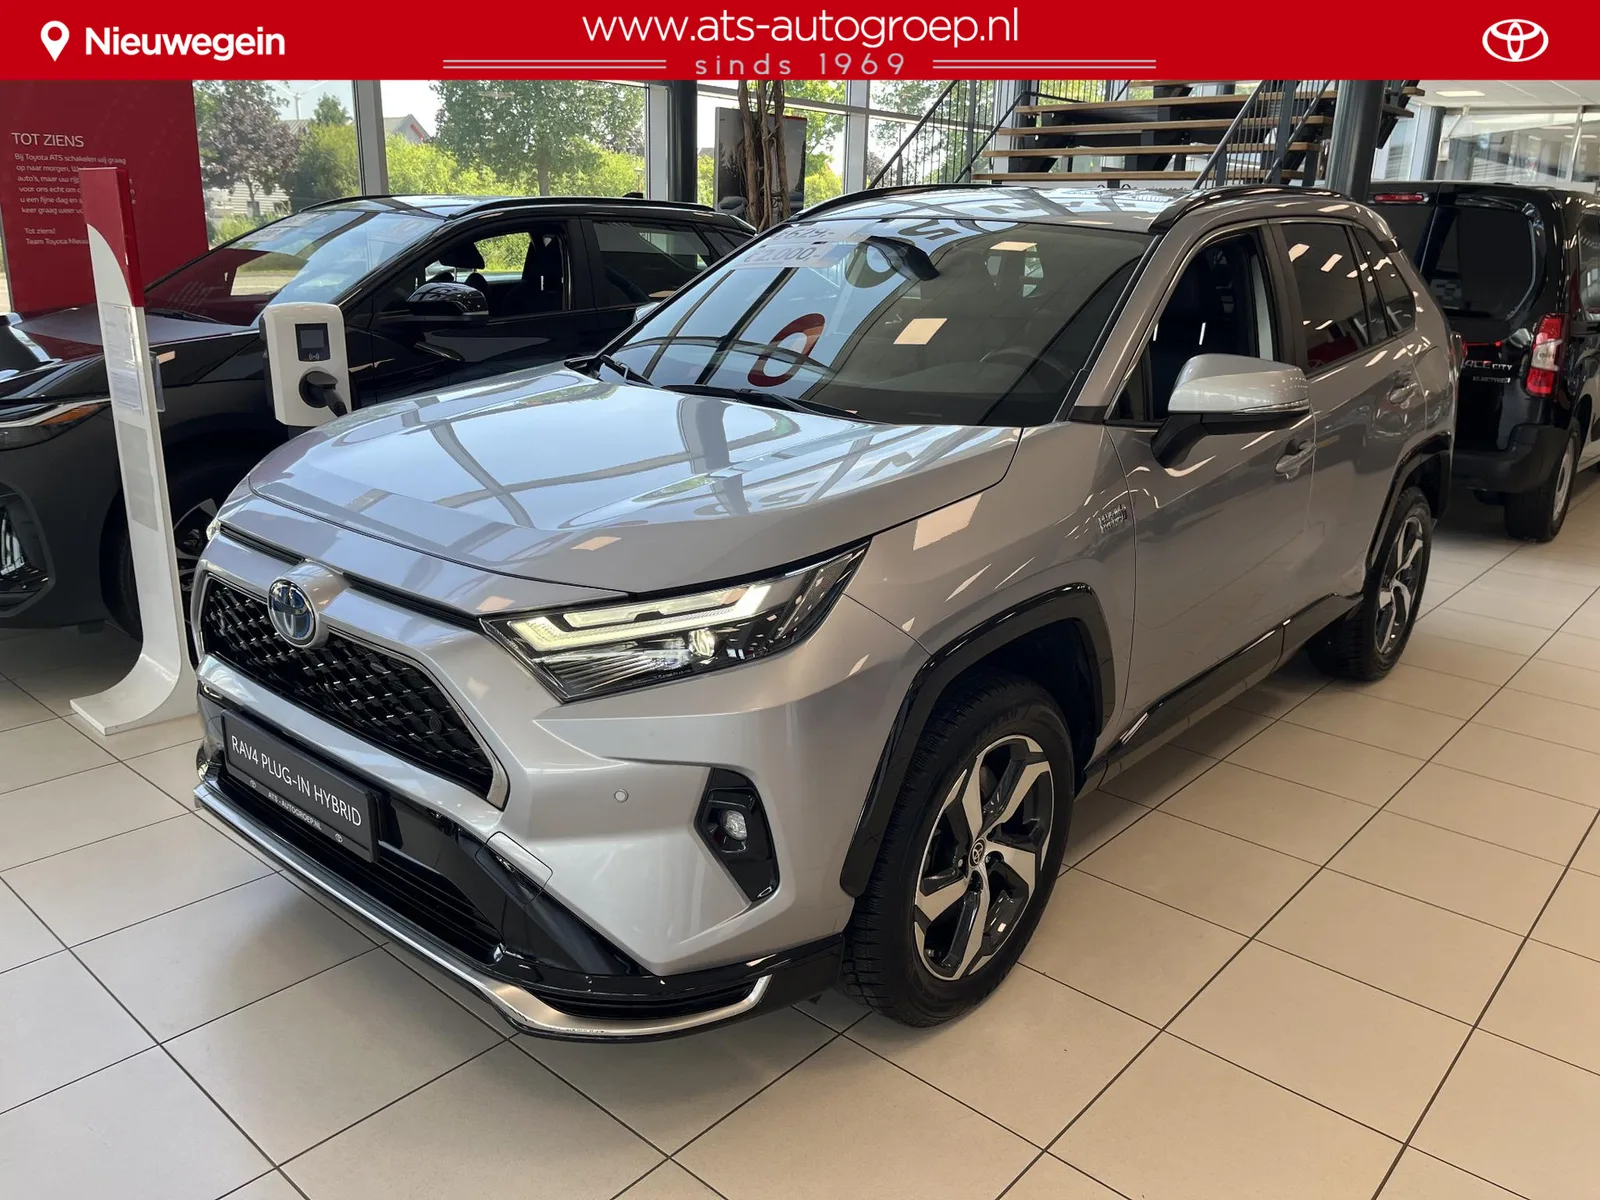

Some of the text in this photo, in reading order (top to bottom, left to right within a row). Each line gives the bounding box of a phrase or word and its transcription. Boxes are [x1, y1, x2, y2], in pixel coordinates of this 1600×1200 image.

[11, 132, 85, 148] TOT ZIENS
[14, 153, 24, 162] Bij
[25, 153, 48, 162] Toyota
[64, 155, 97, 163] schakelen
[107, 157, 127, 165] graag
[25, 227, 36, 235] Tot
[45, 238, 68, 246] Toyota
[231, 735, 362, 827] RAV4 PLUG-IN HYBRID
